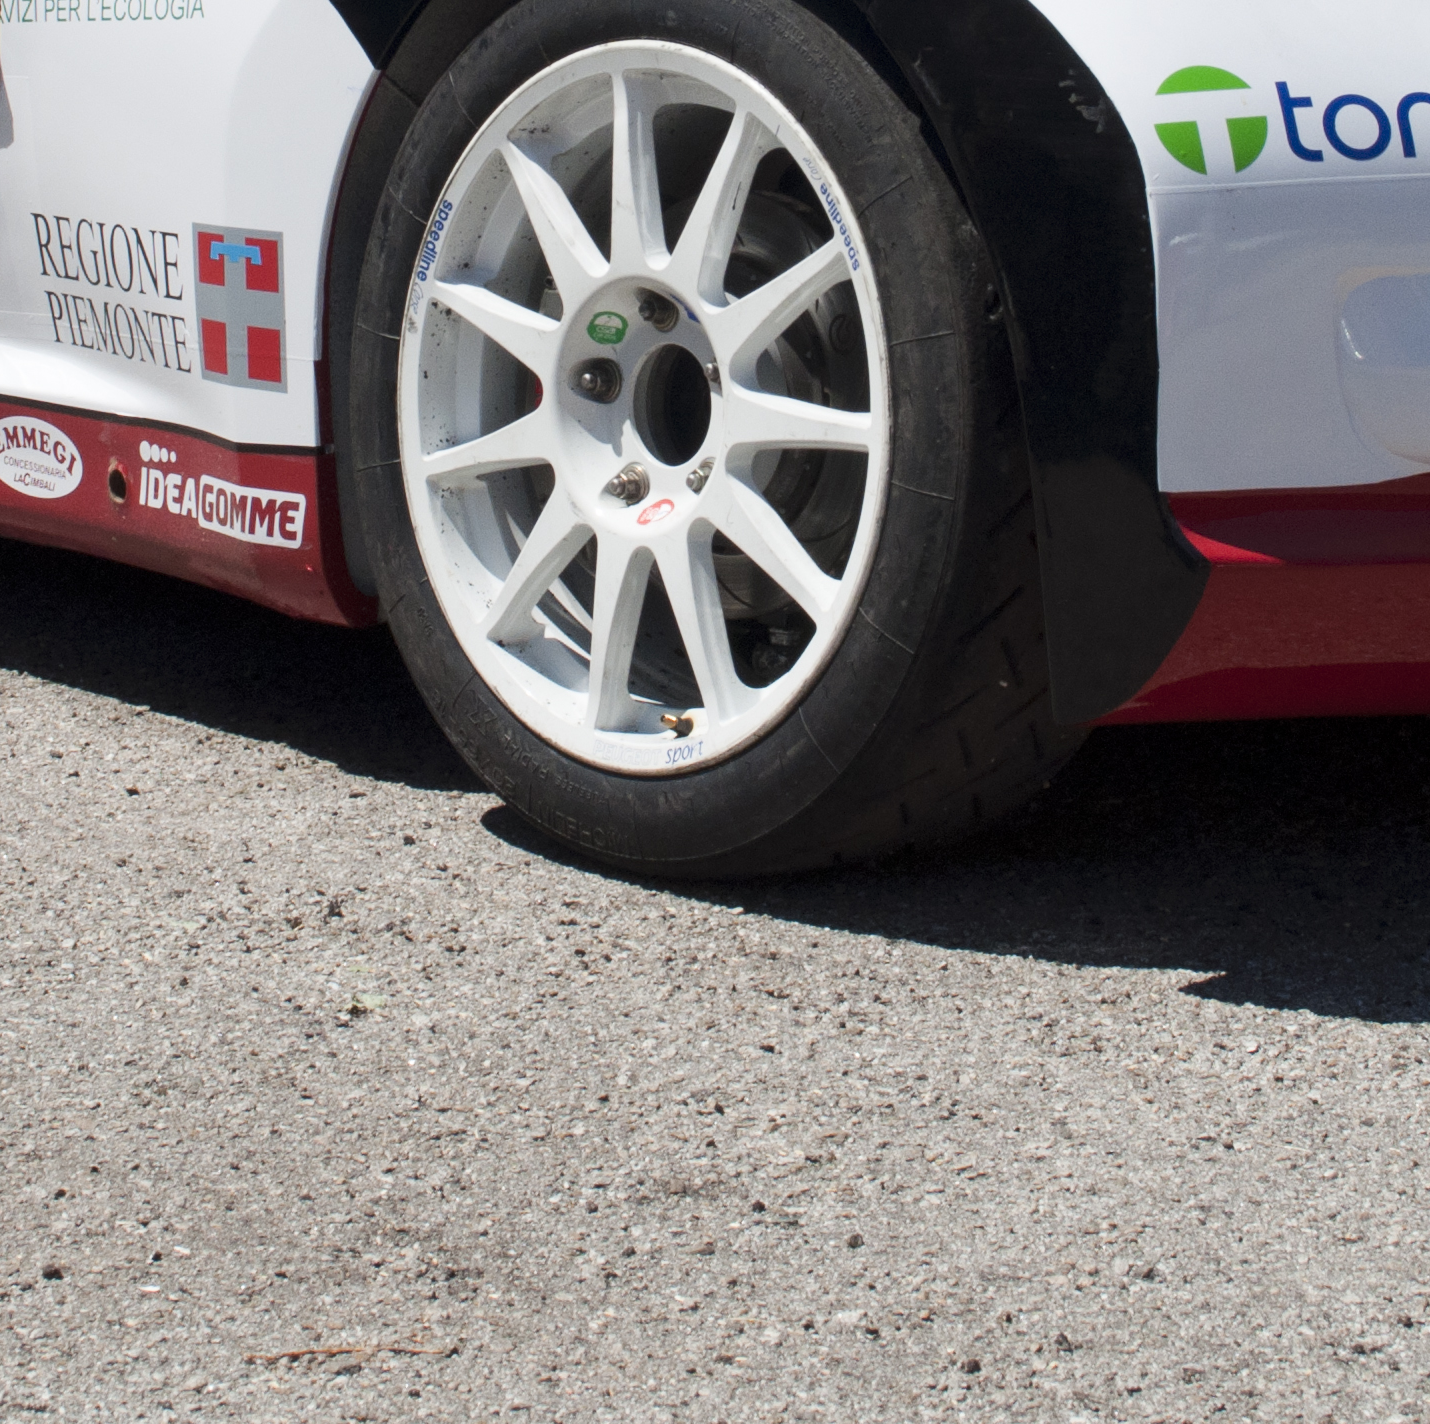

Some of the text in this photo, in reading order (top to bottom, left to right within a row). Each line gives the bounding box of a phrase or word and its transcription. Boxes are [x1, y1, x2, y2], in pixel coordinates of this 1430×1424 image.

[30, 212, 183, 301] REGIONE
[417, 199, 453, 282] speedline
[819, 182, 860, 271] speedline
[44, 290, 192, 374] PIEMONTE
[4, 456, 67, 480] CONCESSIONARIA
[665, 740, 704, 766] sport
